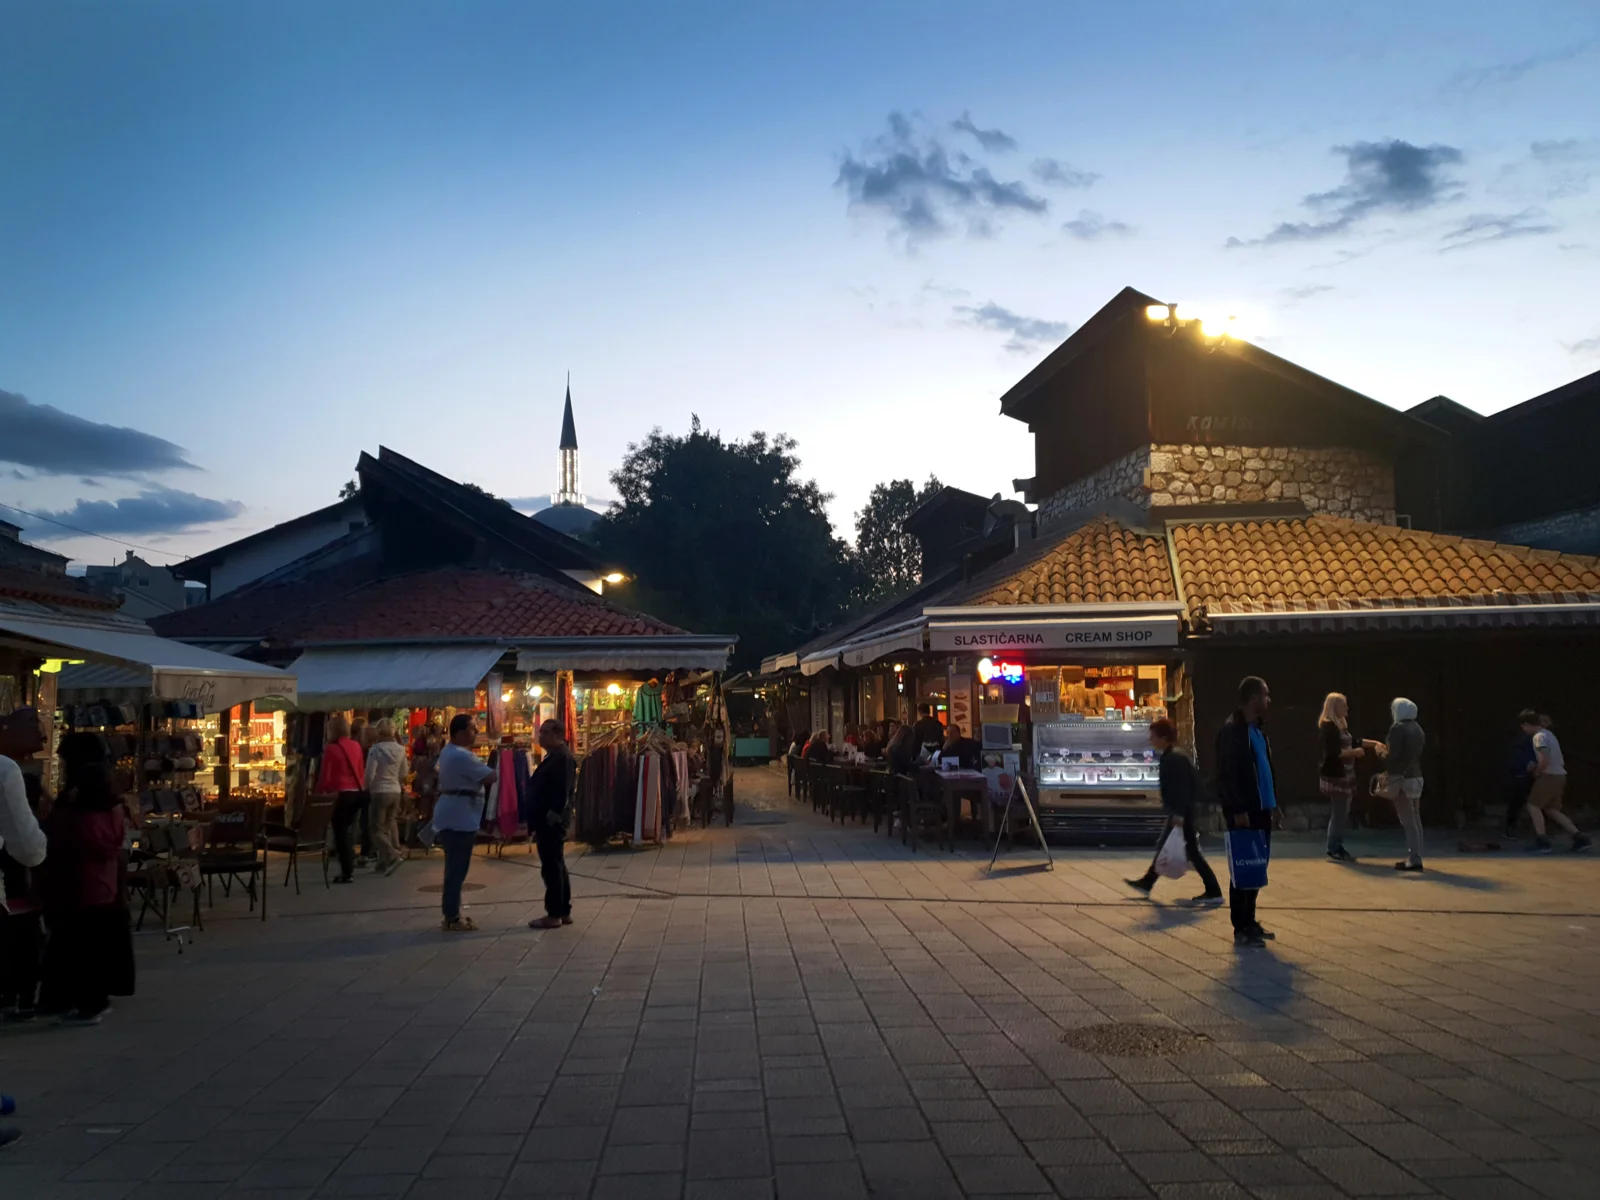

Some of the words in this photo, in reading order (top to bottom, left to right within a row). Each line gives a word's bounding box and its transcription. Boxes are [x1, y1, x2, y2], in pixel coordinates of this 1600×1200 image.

[954, 631, 1044, 646] SLASTIČARNA
[1065, 631, 1112, 643] CREAM
[1116, 630, 1153, 642] SHOP
